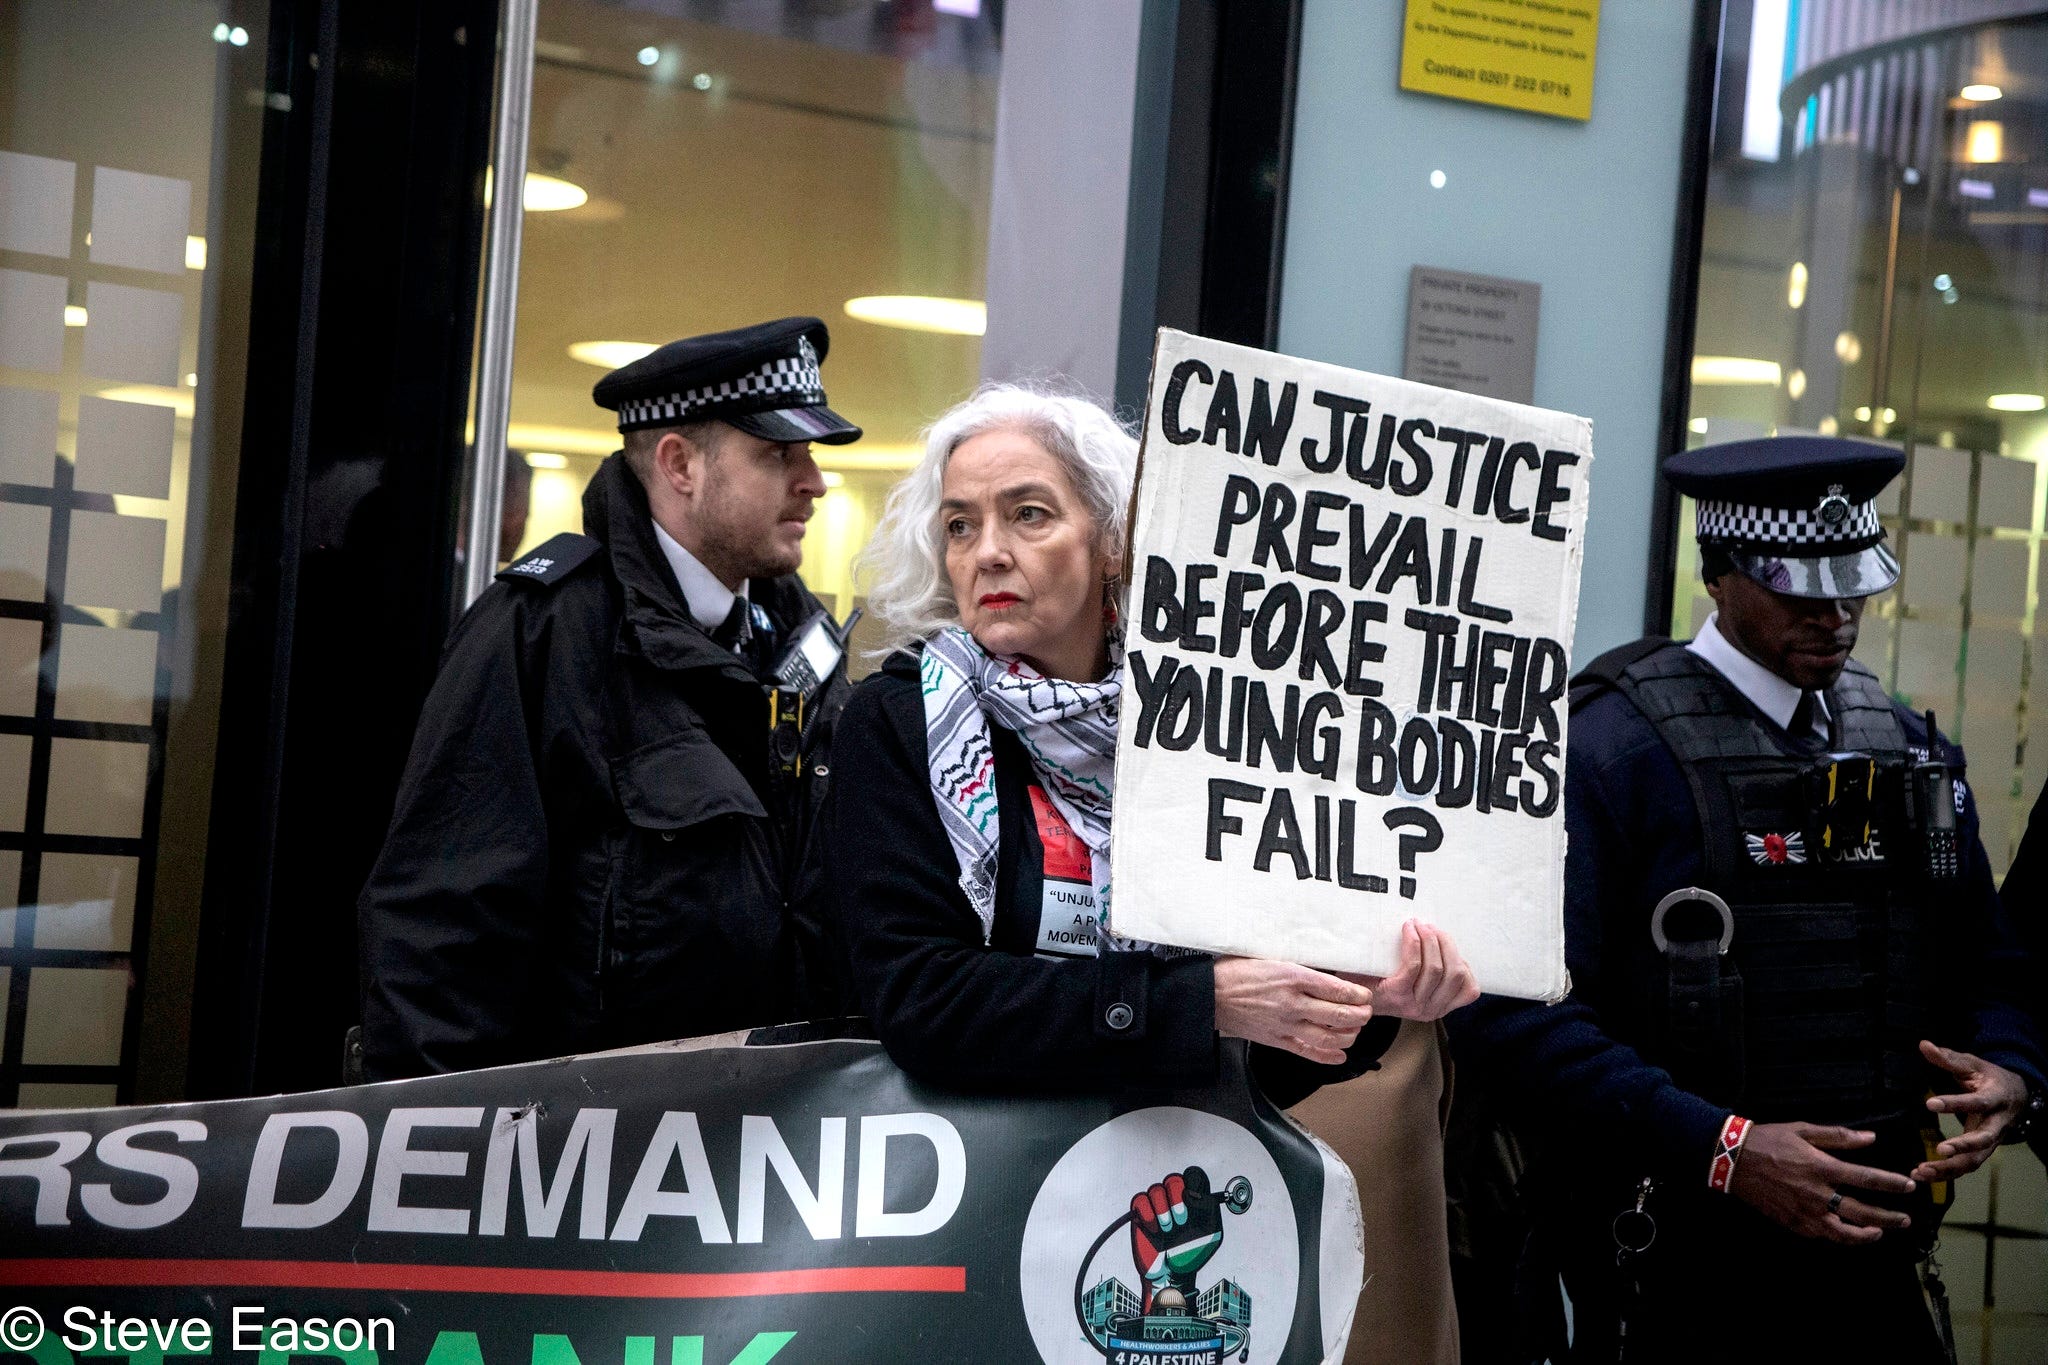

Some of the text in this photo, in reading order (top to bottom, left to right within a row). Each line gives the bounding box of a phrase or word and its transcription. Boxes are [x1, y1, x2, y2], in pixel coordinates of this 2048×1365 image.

[1423, 58, 1476, 80] Contact
[1162, 358, 1580, 542] CAN JUSTICE
[1214, 474, 1513, 624] PREVAIL
[1140, 555, 1566, 742] BEFORE THEIR
[1128, 651, 1560, 819] YOUNG BODIES
[1050, 890, 1096, 908] “UNJU
[1205, 777, 1444, 900] FAIL?
[1073, 913, 1096, 927] A P
[241, 1107, 967, 1244] DEMAND
[1115, 1351, 1217, 1365] 4 PALESTINE
[1120, 1341, 1181, 1350] HEALTHWORKERS
